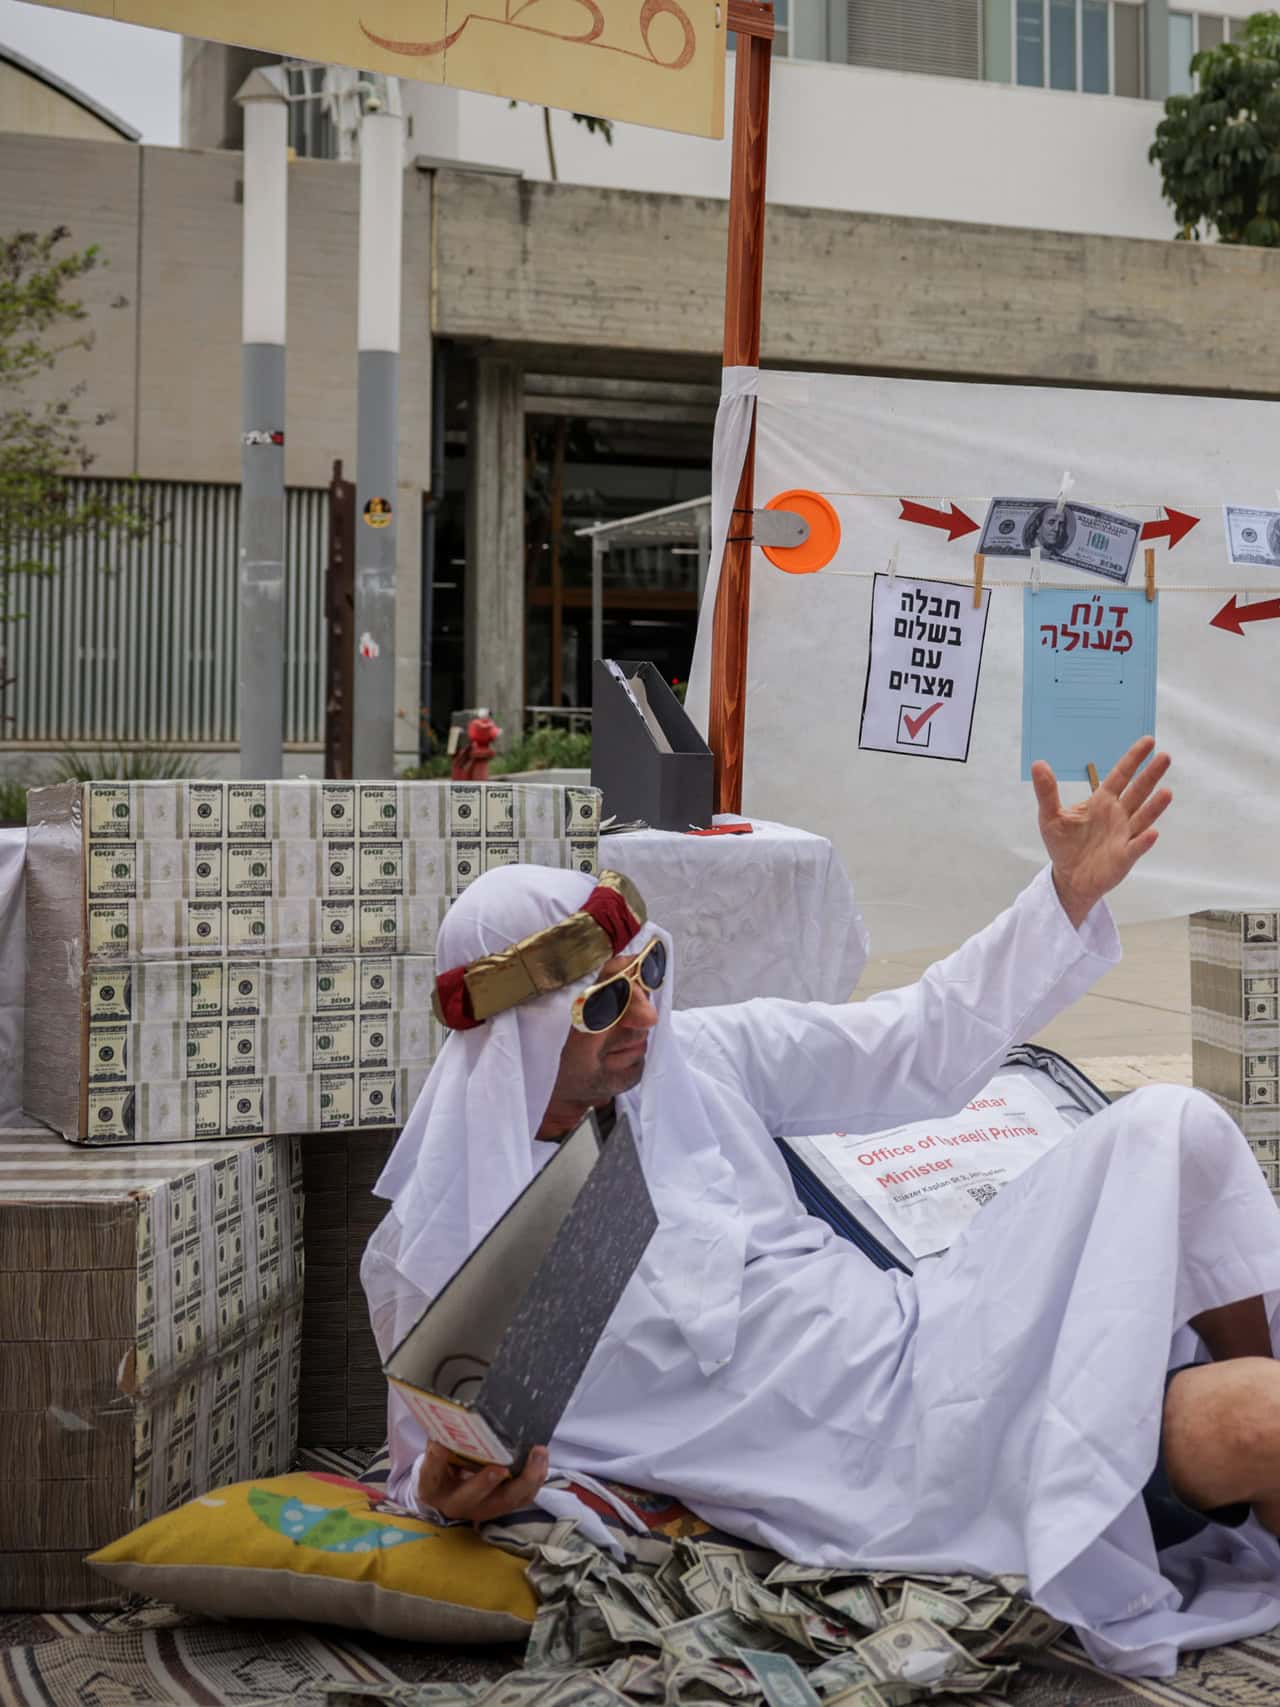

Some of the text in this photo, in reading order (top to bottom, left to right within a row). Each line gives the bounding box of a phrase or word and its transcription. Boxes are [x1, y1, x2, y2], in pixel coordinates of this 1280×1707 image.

[900, 588, 961, 619] חבלה
[893, 615, 962, 647] בשלום
[1039, 623, 1134, 653] פעולה
[911, 647, 943, 670] עם
[888, 669, 954, 698] מצרים
[857, 1144, 916, 1166] Office
[917, 1135, 937, 1149] of
[988, 1124, 1039, 1141] Prime
[876, 1157, 954, 1189] Minister
